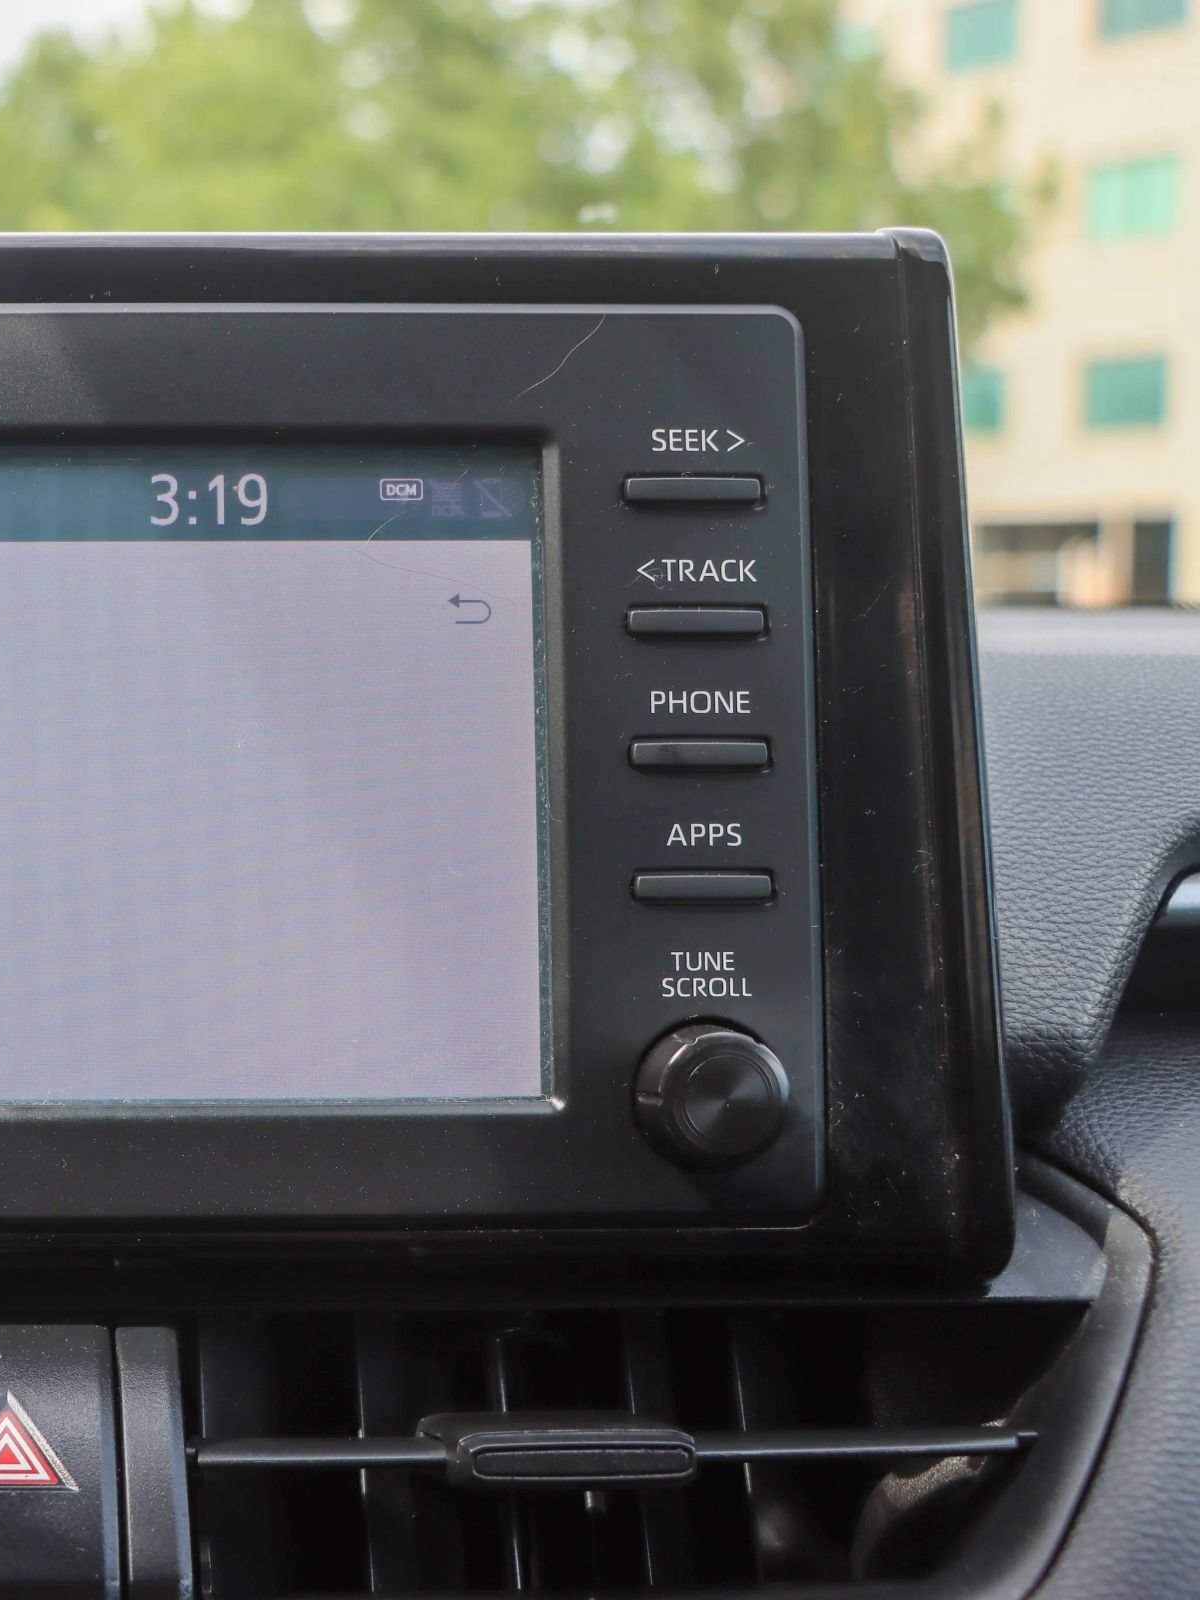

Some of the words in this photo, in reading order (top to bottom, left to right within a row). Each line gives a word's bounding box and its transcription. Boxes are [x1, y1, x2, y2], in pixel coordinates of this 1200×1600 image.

[148, 473, 269, 526] 3:19
[386, 483, 417, 496] DCM
[650, 690, 752, 714] PHONE
[666, 822, 743, 847] APPS
[670, 951, 736, 972] TUNE
[661, 977, 753, 998] SCROLL
